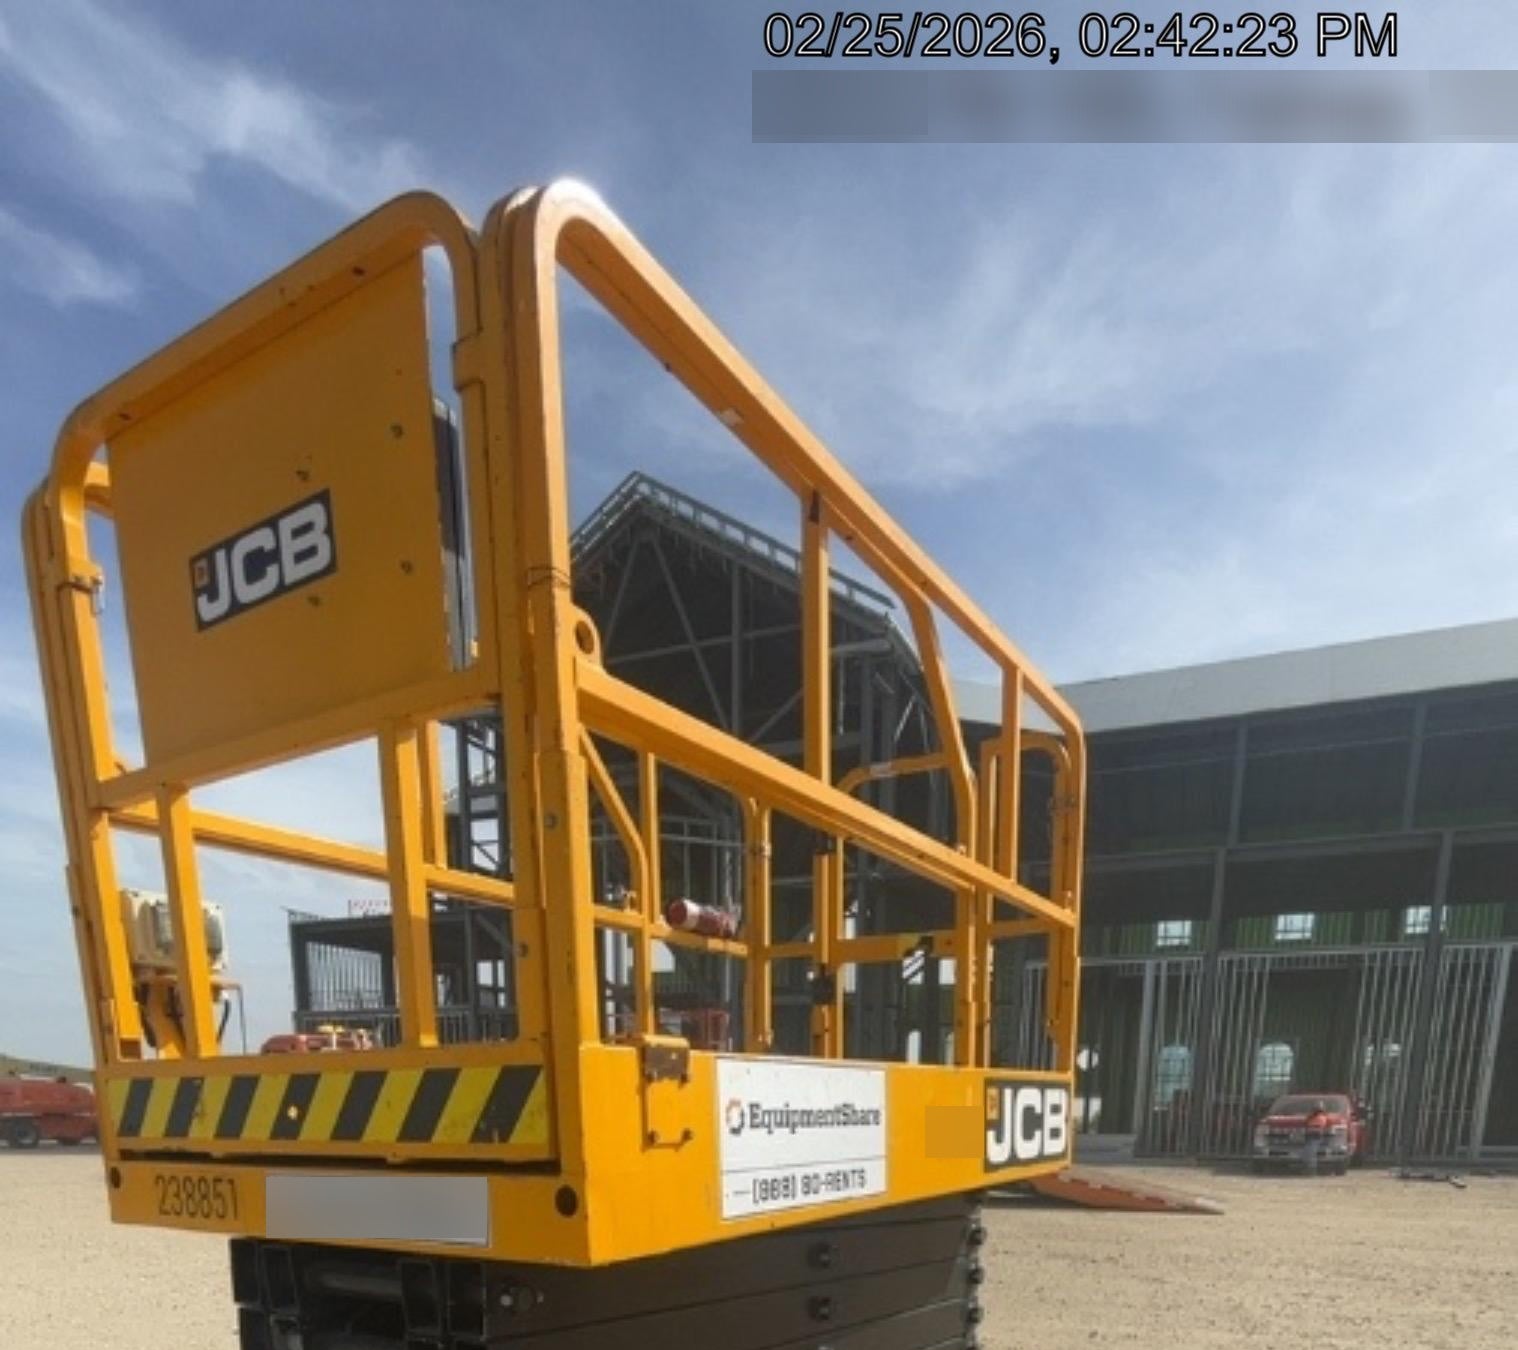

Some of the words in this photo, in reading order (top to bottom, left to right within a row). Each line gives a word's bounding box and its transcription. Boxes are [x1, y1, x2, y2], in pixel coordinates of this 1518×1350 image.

[197, 502, 331, 622] JCB
[749, 1102, 881, 1134] EquipmentShare
[986, 1087, 1068, 1164] JCB
[155, 1174, 238, 1220] 238851
